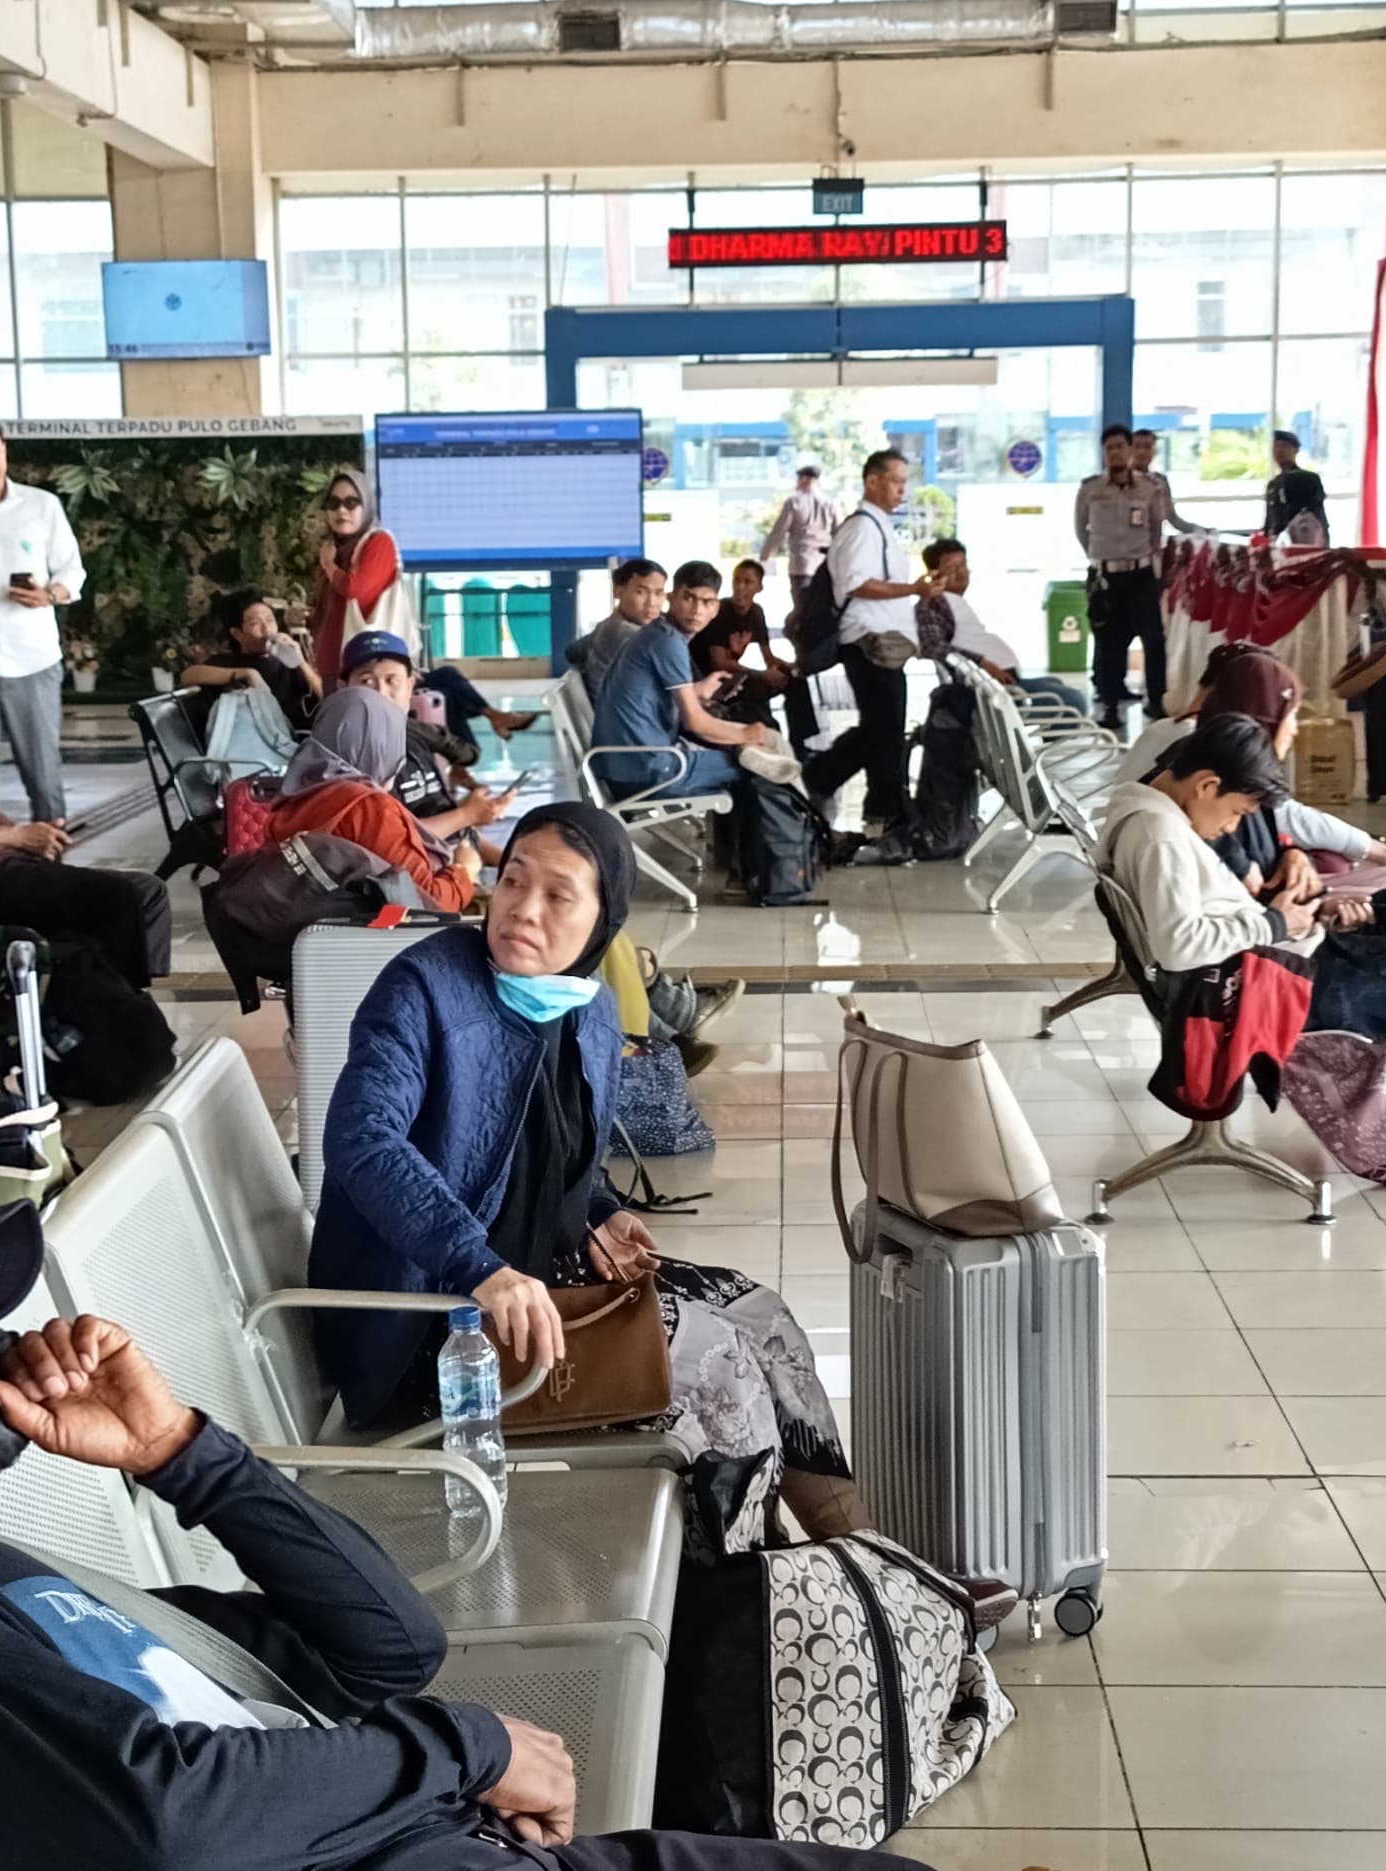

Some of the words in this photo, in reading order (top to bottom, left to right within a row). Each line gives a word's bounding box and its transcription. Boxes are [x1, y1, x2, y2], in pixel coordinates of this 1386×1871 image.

[821, 193, 853, 212] EXIT
[688, 233, 814, 260] DHARMA
[894, 228, 979, 255] PINTU
[984, 227, 1003, 253] 3
[6, 422, 90, 435] TERMINAL
[96, 421, 173, 434] TERPADU
[178, 420, 223, 433] PULO
[228, 418, 297, 432] GEBANG
